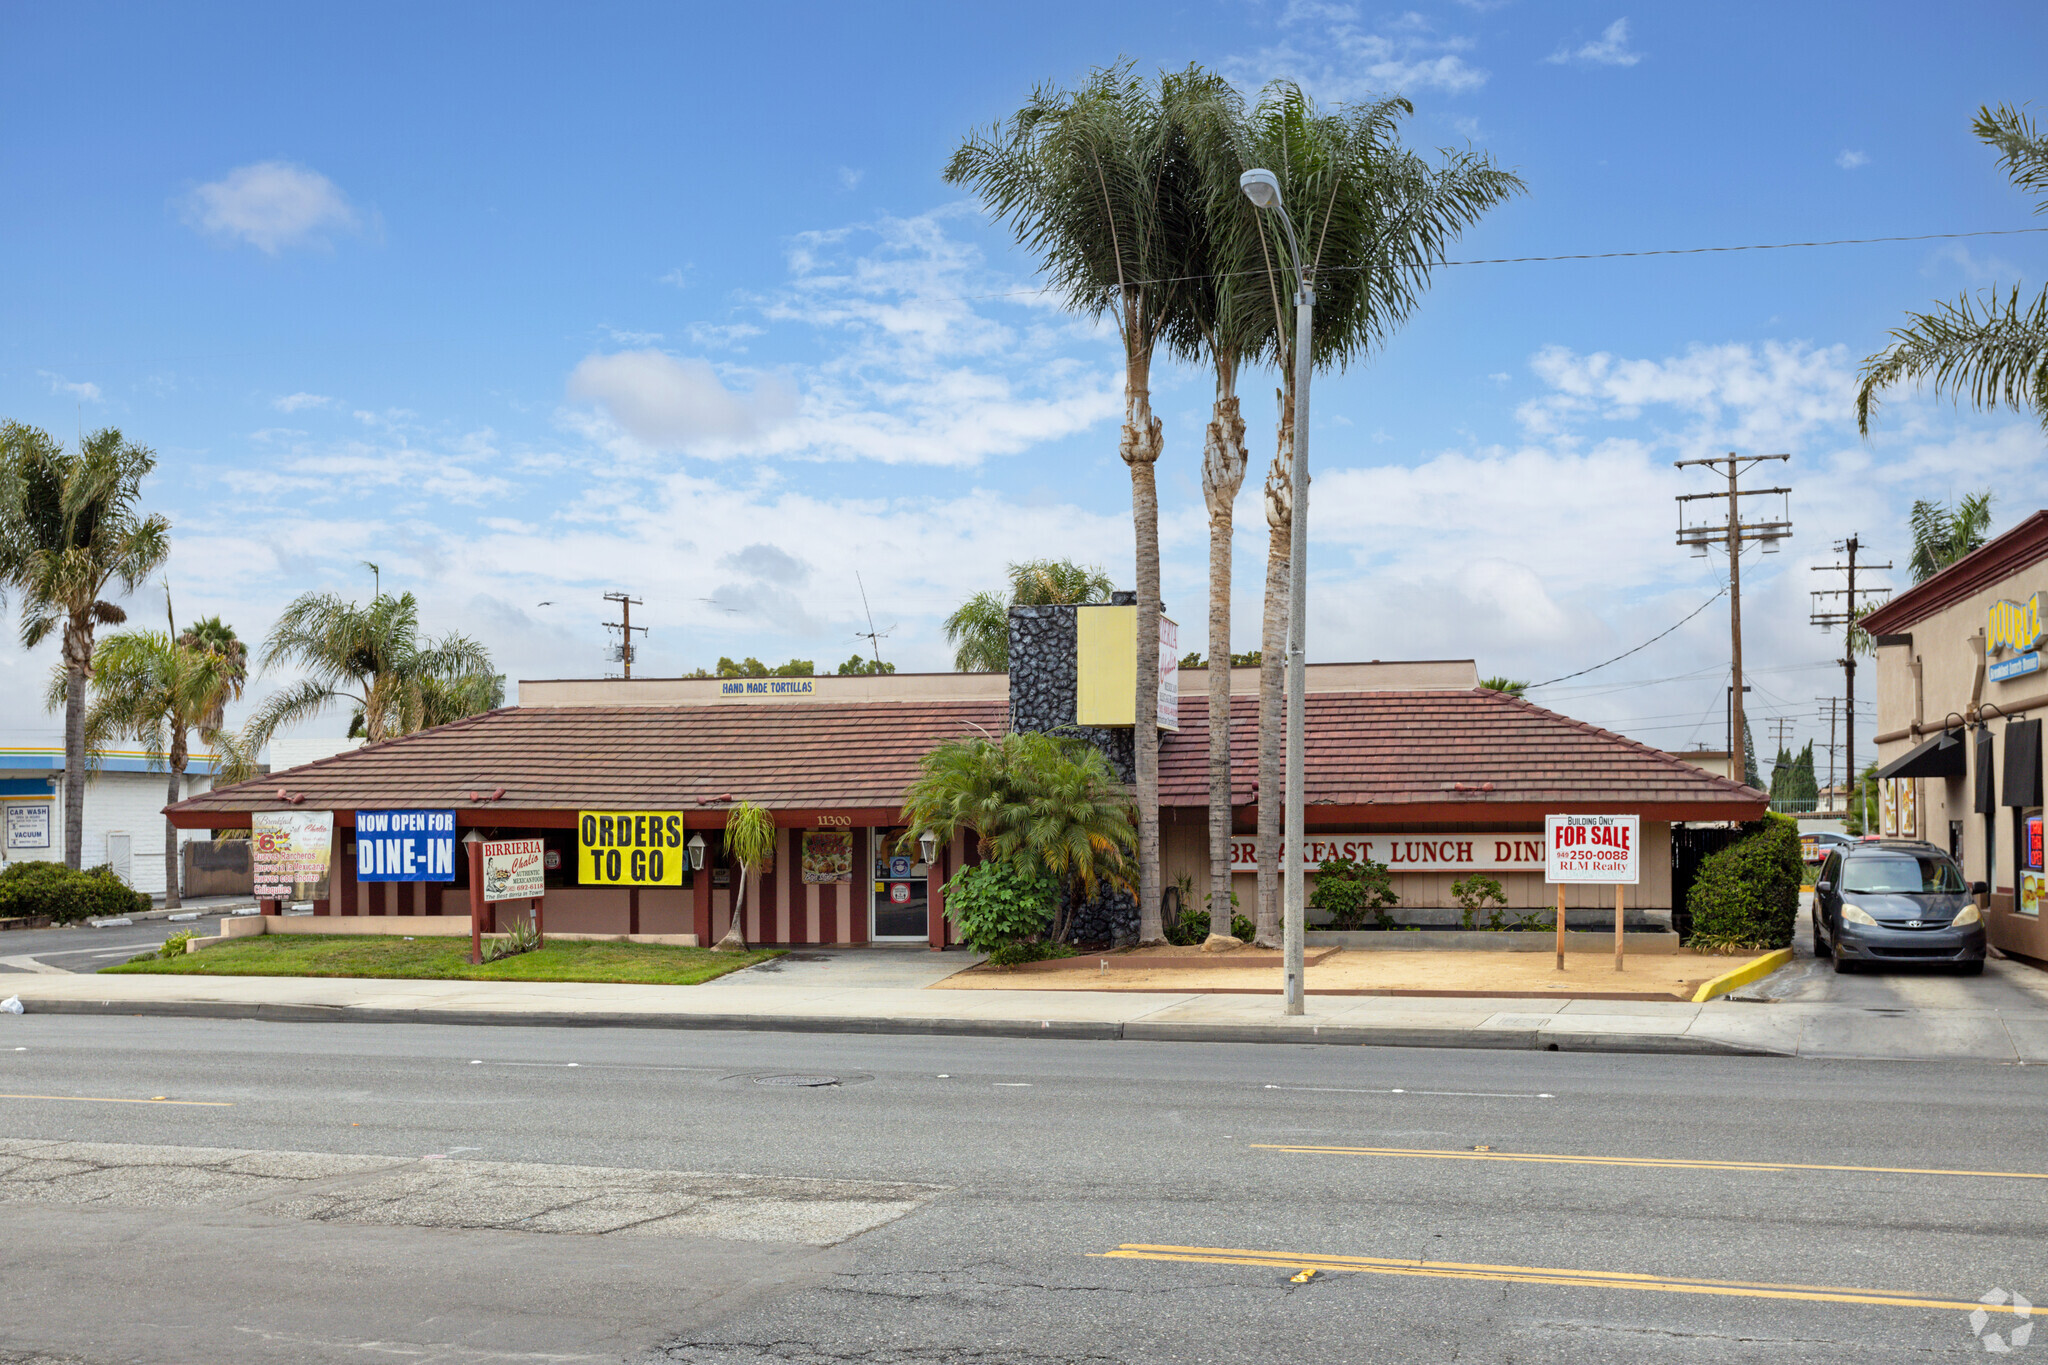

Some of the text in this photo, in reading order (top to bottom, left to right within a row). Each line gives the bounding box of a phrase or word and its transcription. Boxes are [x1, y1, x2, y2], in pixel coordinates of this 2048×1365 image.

[1986, 591, 2041, 656] DOUBLZ
[722, 681, 812, 694] HAND MADE TORTILLAS
[358, 814, 453, 832] NOW OPEN FOR
[817, 815, 851, 826] 11300
[582, 815, 681, 848] ORDERS
[1556, 826, 1630, 851] FOR SALE
[259, 834, 275, 851] 6
[484, 841, 541, 857] BIRRIERIA
[254, 851, 316, 861] Huevos Rancheros
[359, 838, 453, 874] DINE-IN
[1391, 841, 1473, 863] LUNCH
[1570, 850, 1628, 860] 250-0088
[254, 863, 279, 871] Huevos
[294, 862, 325, 871] Mexicana
[511, 854, 539, 874] Chalio
[591, 849, 664, 882] TO GO
[1560, 861, 1628, 873] RLM Realty
[254, 874, 279, 883] Huevos
[294, 873, 319, 882] Chorizo
[516, 869, 540, 877] AUTHENTIC
[517, 883, 544, 891] 692-6118
